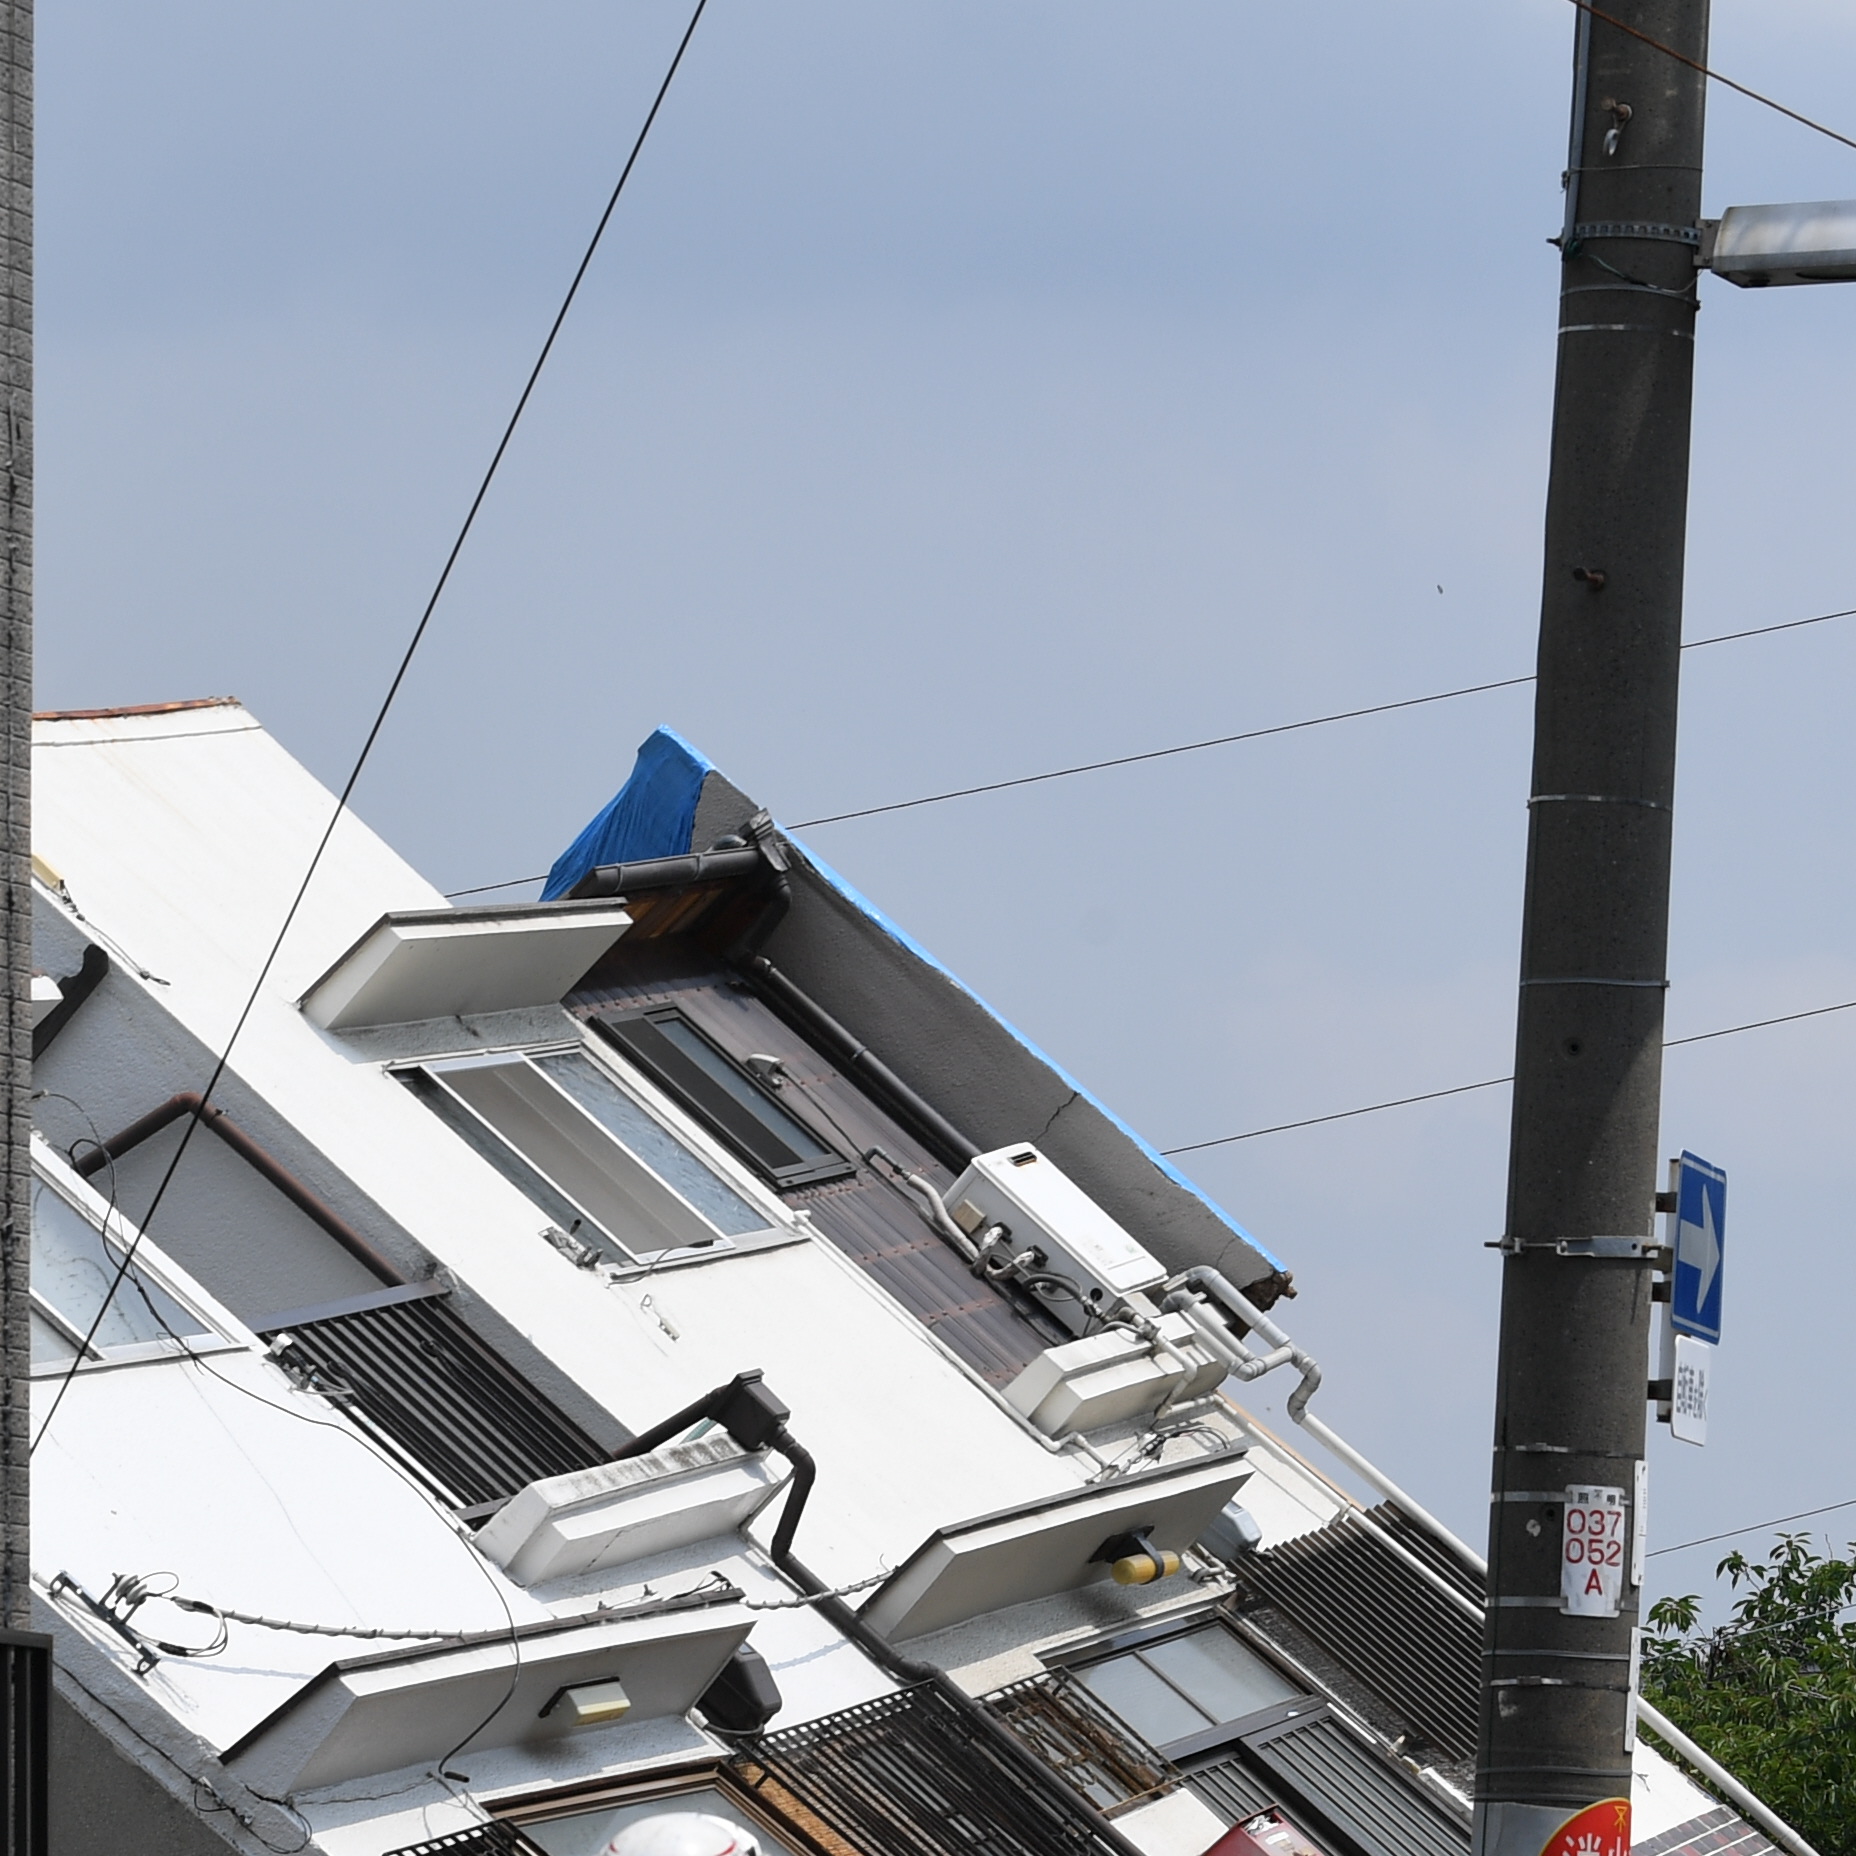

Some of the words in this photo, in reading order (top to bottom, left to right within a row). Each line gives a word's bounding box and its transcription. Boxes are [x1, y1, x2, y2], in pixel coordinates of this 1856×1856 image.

[1567, 1509, 1622, 1537] 037
[1566, 1538, 1622, 1567] 052
[1585, 1568, 1603, 1596] A
